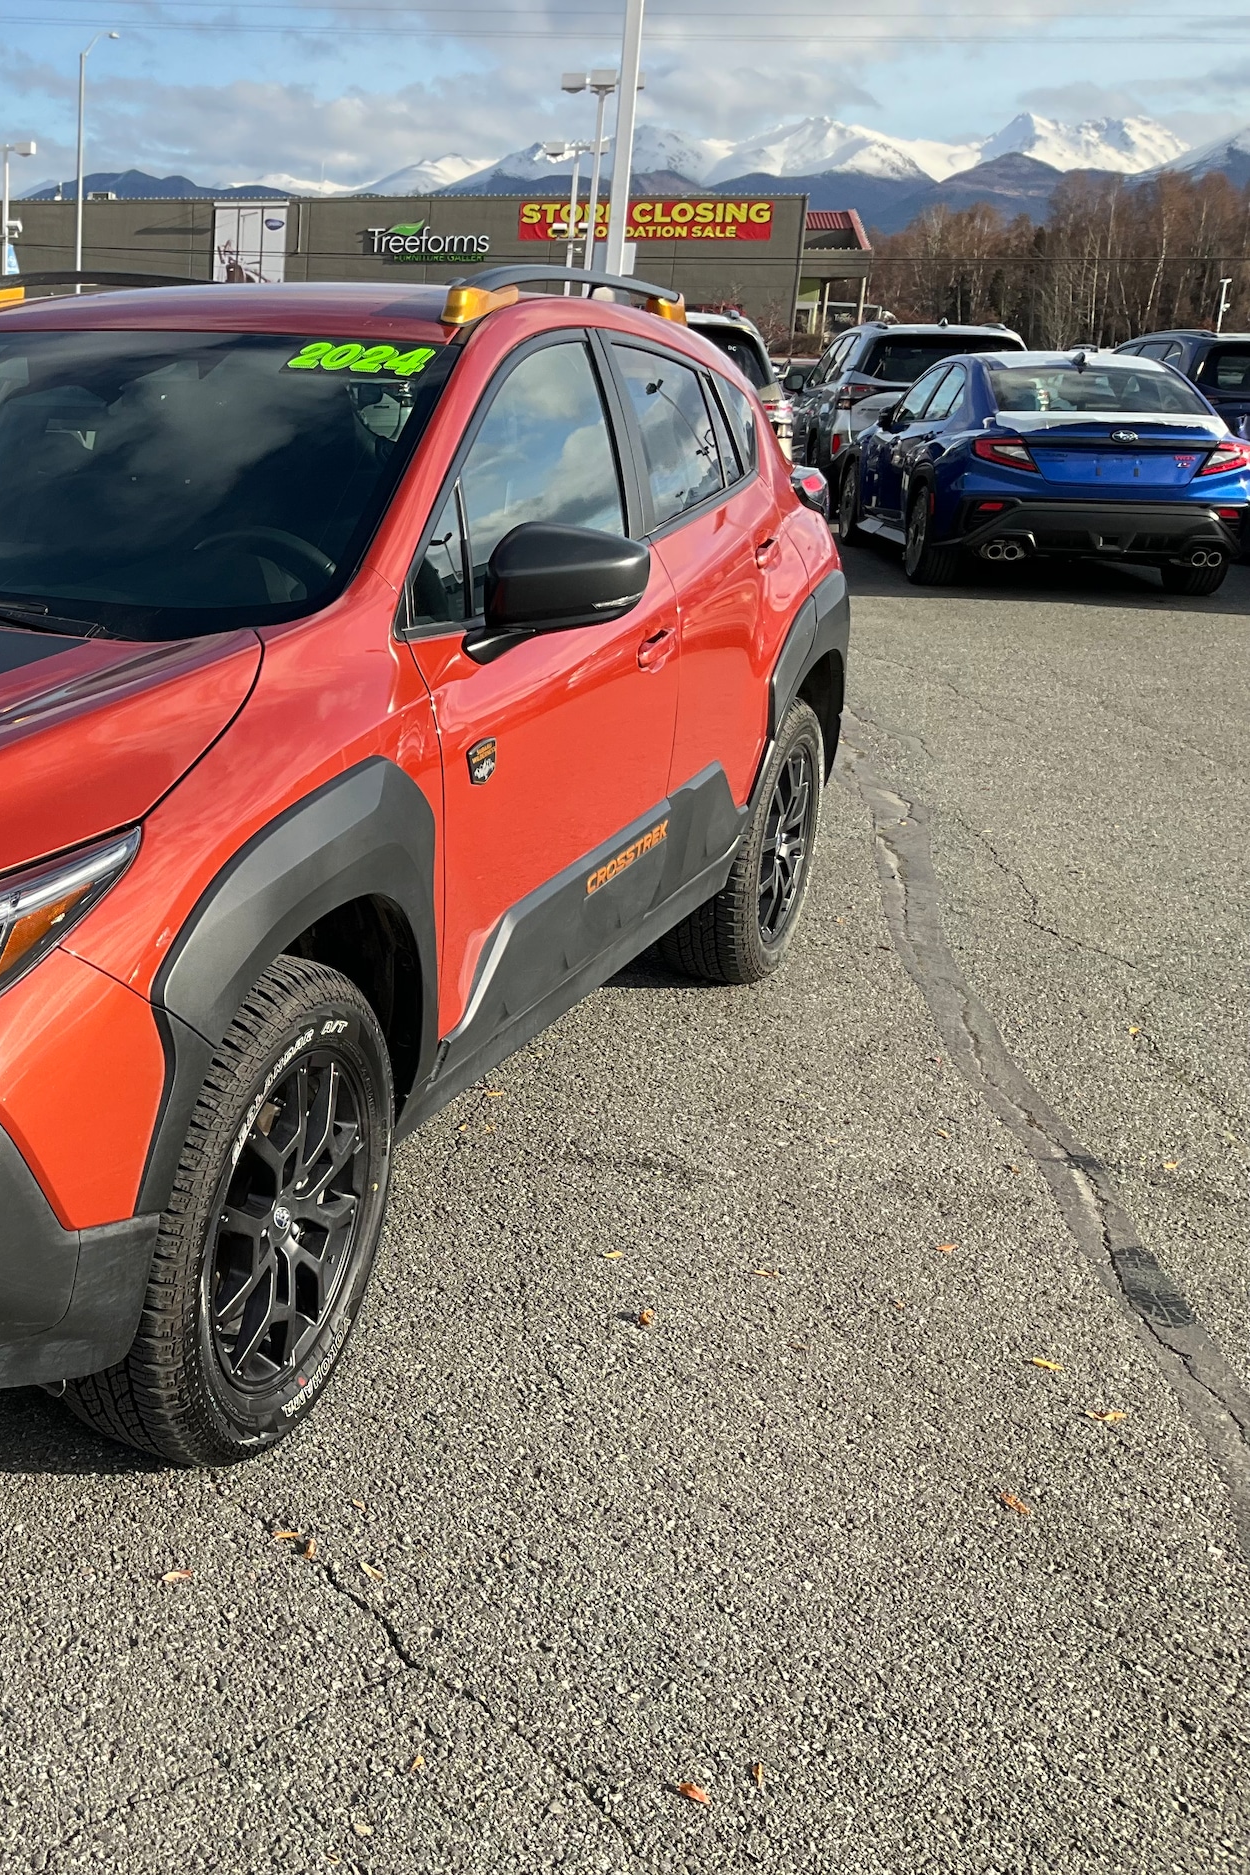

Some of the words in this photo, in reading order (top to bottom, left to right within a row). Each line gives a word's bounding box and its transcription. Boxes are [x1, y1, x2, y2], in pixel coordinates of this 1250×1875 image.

[522, 203, 610, 224] STOR
[631, 202, 771, 223] CLOSING
[367, 225, 490, 253] Treeforms
[690, 225, 737, 238] SALE
[287, 342, 437, 377] 2024
[586, 819, 669, 895] CROSSTREK
